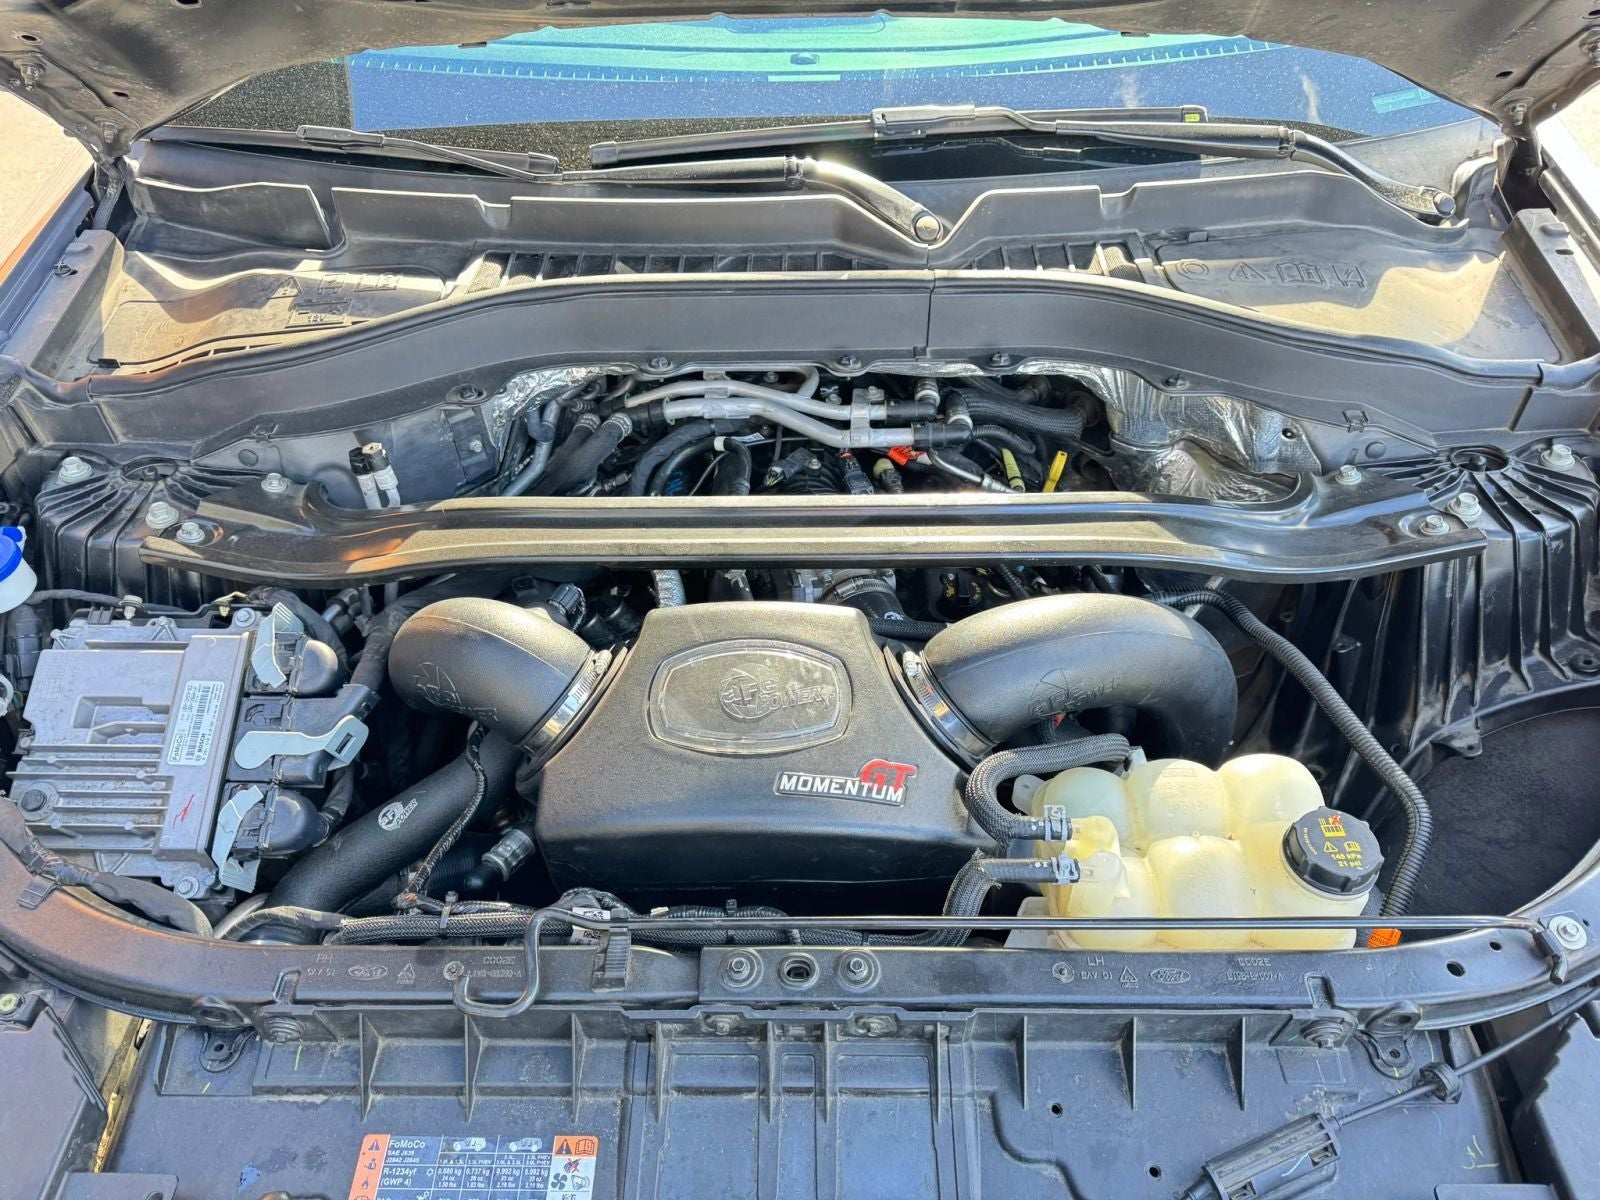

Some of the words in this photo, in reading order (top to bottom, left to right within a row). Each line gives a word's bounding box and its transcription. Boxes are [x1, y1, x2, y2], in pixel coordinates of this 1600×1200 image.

[172, 732, 184, 761] FoMoCo
[197, 733, 206, 753] BOSCH
[860, 759, 918, 789] GT
[779, 773, 903, 802] MOMENTUM
[396, 798, 418, 824] POWER
[1086, 955, 1105, 966] LH
[388, 1140, 426, 1148] FoMoCo
[382, 1168, 416, 1177] R-1234yf
[454, 1168, 462, 1176] kg
[482, 1168, 490, 1176] kg
[512, 1168, 520, 1176] kg
[541, 1168, 548, 1176] kg
[380, 1178, 402, 1187] (GWP
[403, 1178, 412, 1187] 4)
